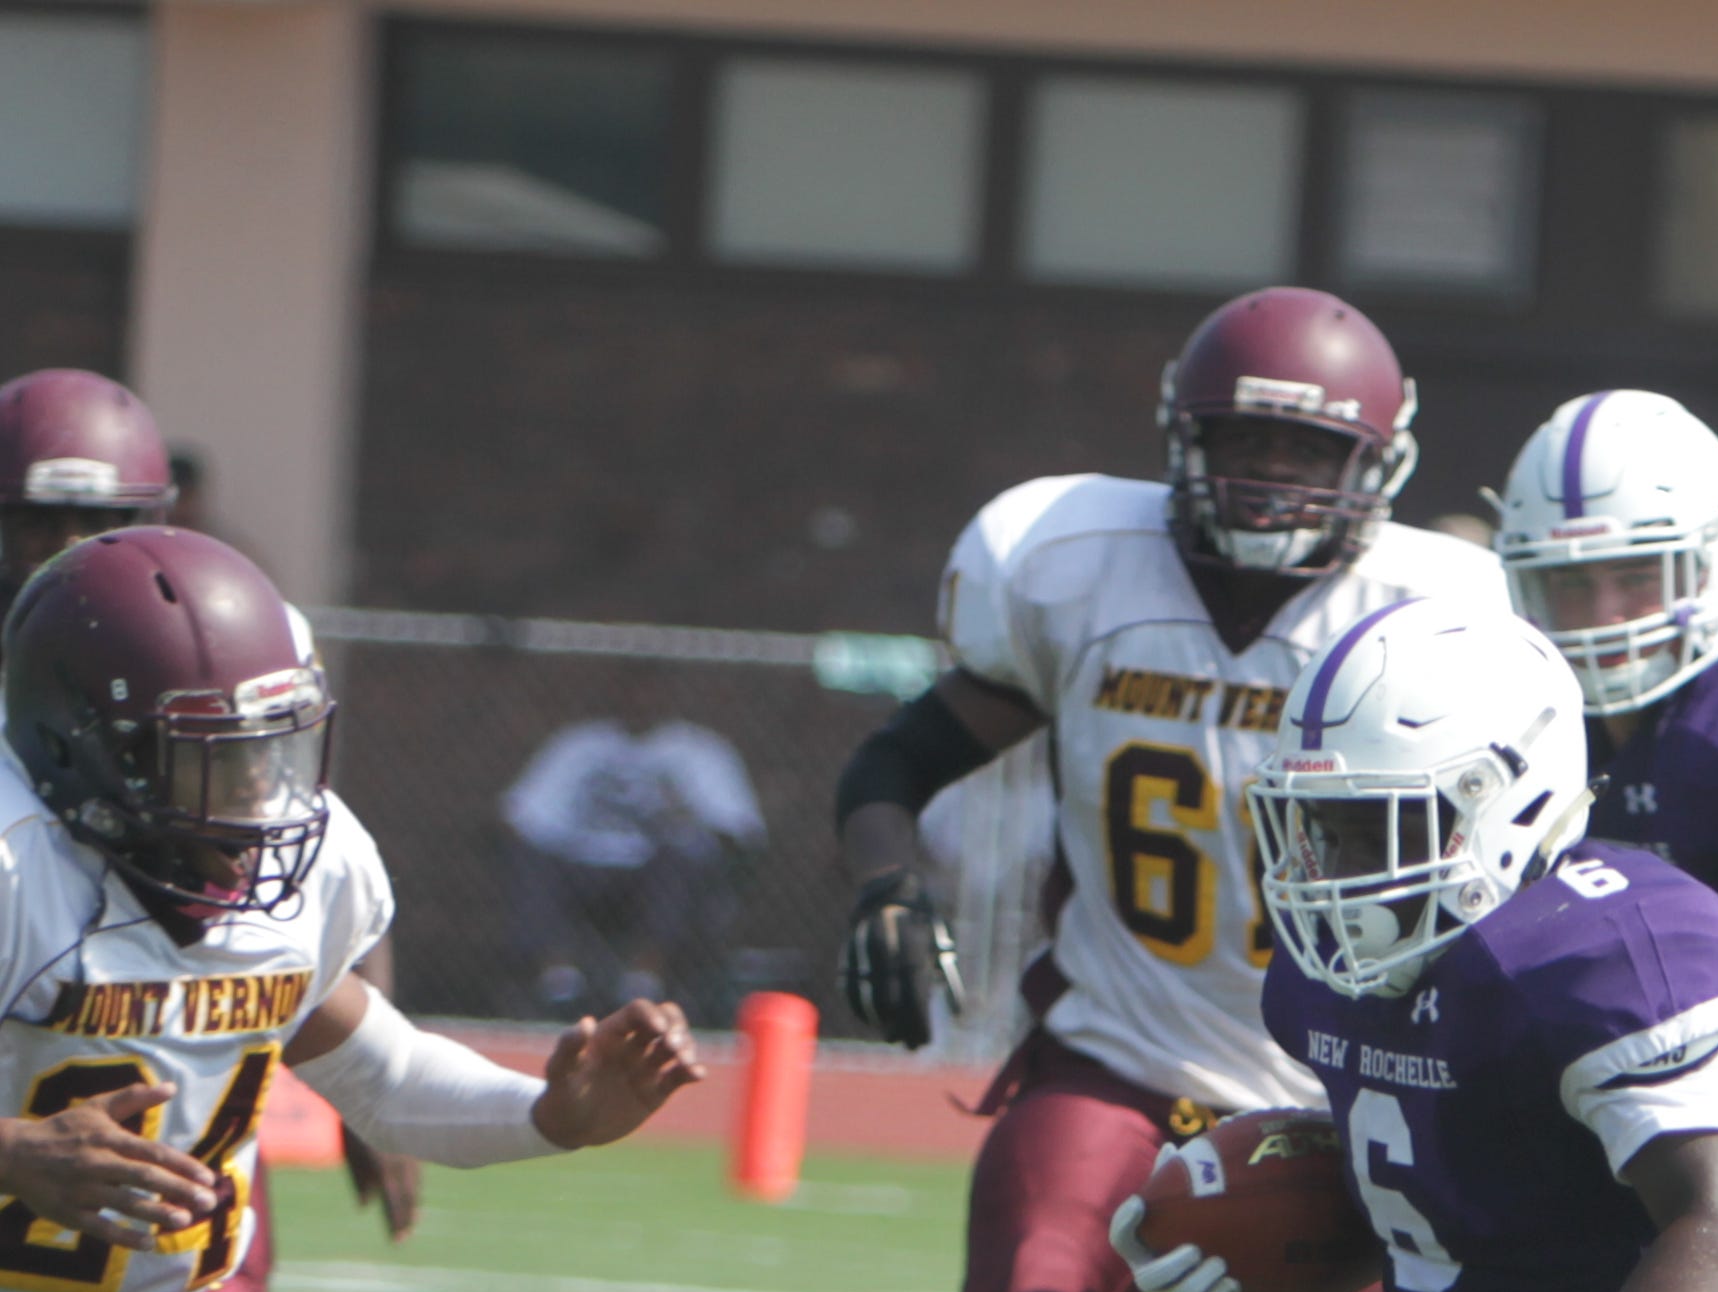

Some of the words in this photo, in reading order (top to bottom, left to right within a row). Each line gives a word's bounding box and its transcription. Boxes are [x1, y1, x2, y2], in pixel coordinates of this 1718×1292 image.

[1217, 682, 1293, 734] VER
[1556, 853, 1630, 899] 6
[1307, 1028, 1349, 1070] NEW
[1359, 1043, 1457, 1089] ROCHELLE
